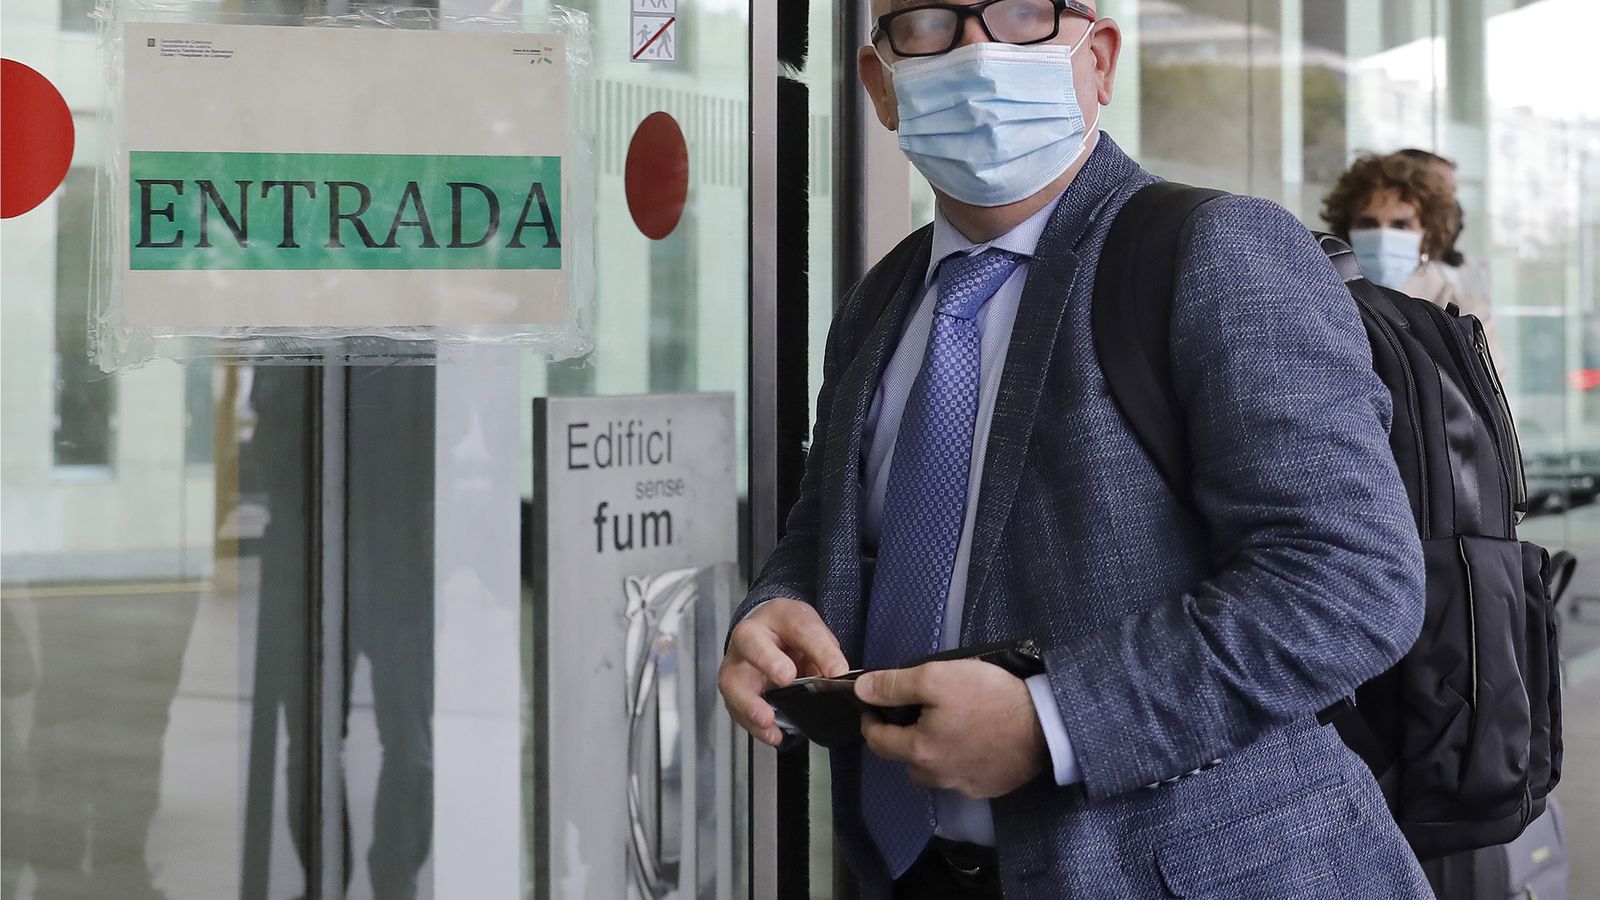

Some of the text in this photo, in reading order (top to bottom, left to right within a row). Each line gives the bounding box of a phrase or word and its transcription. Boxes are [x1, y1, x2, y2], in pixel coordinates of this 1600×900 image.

[135, 179, 561, 249] ENTRADA
[568, 419, 672, 470] Edifici
[635, 478, 685, 499] sense
[594, 502, 673, 553] fum
